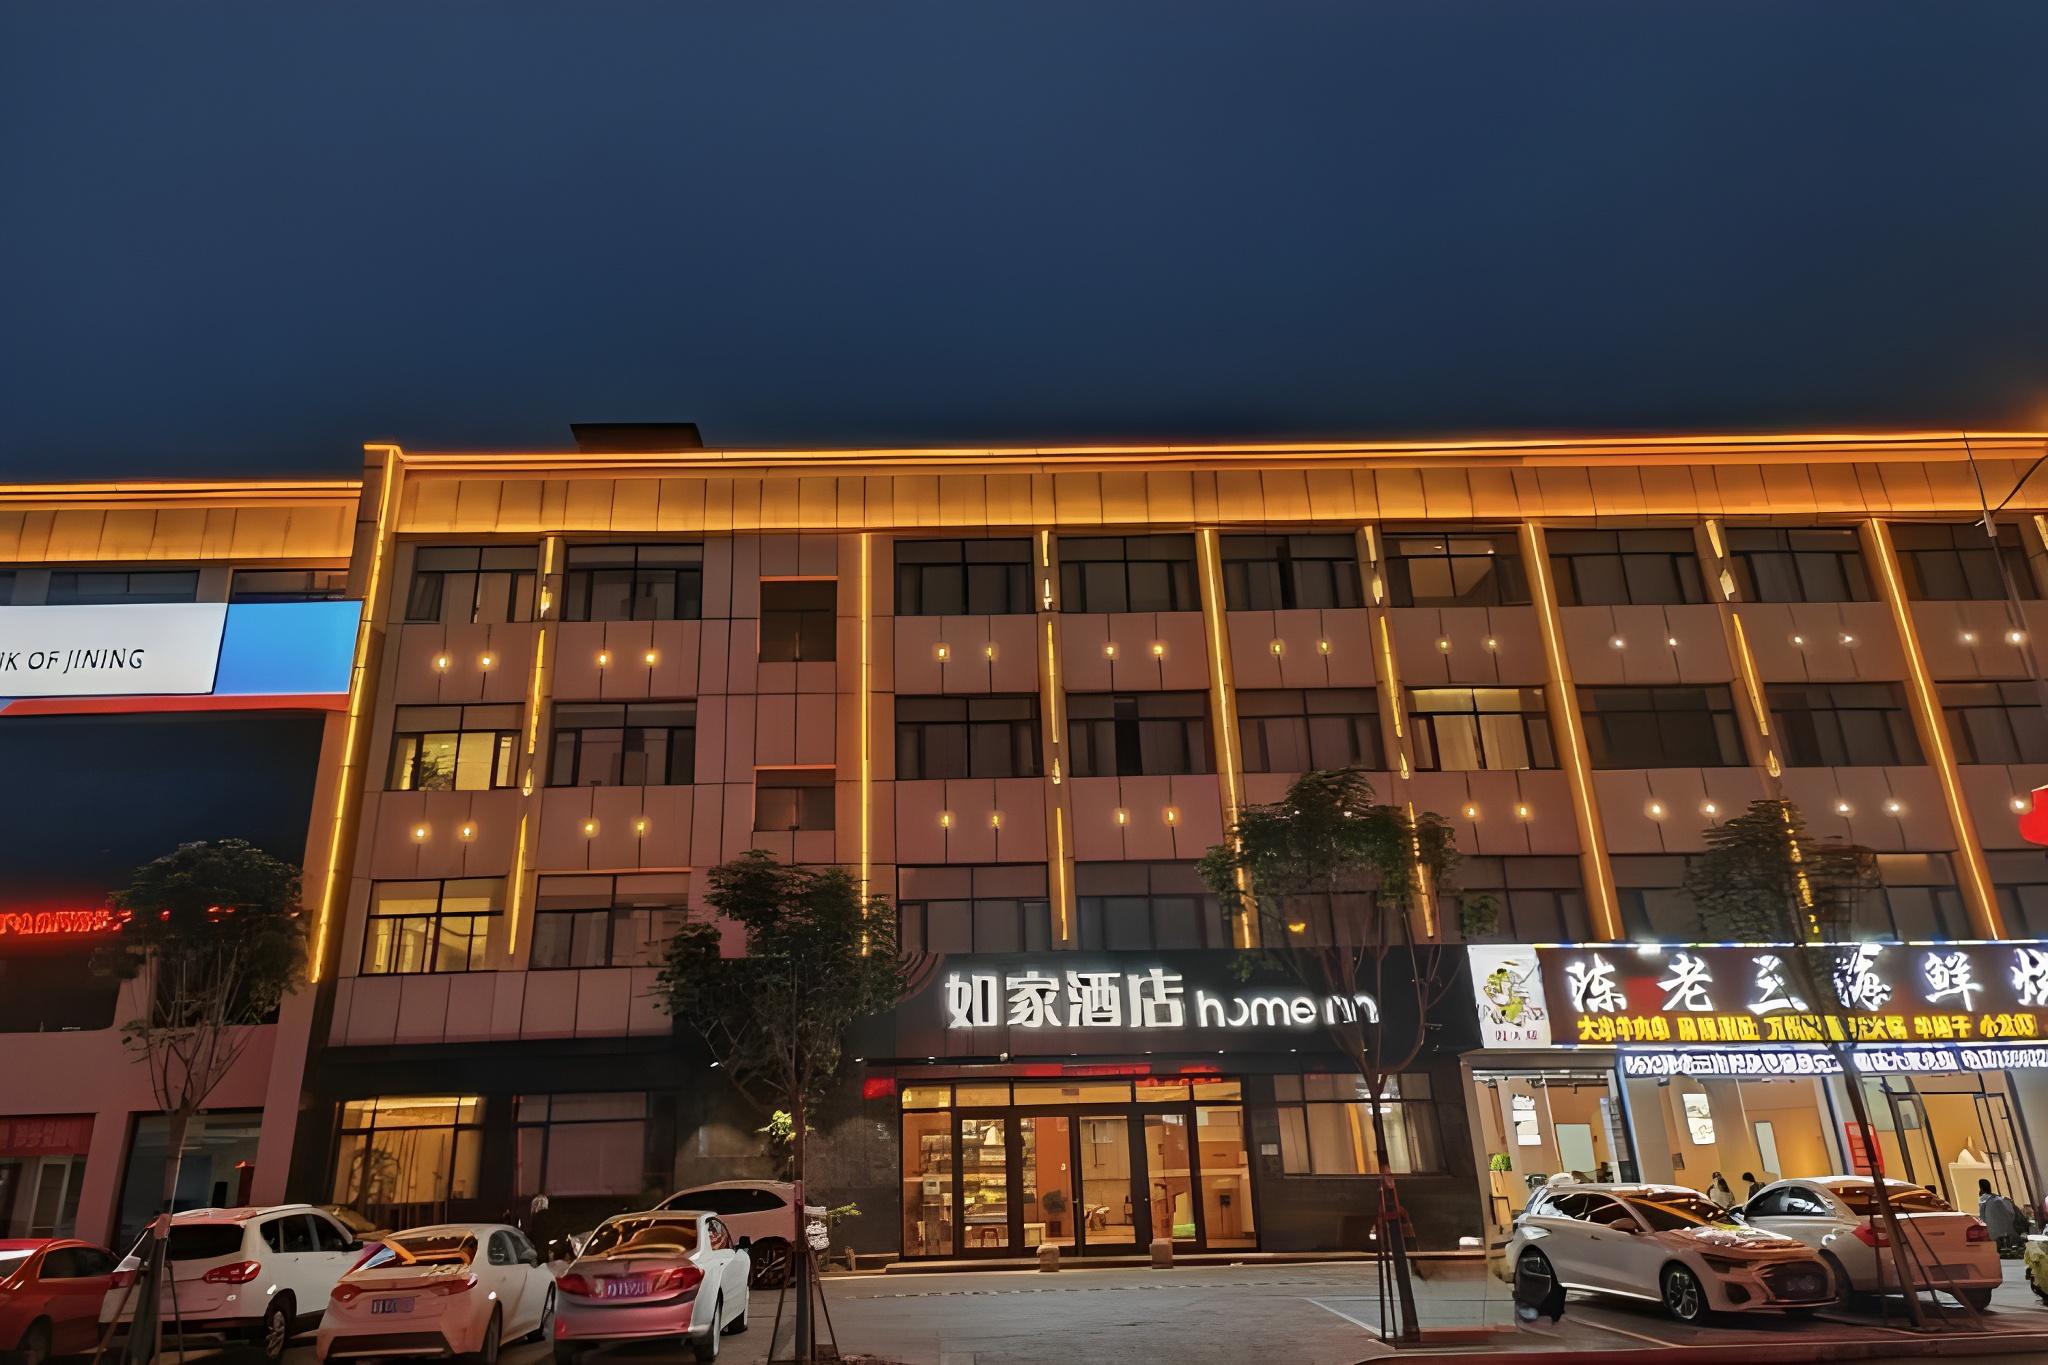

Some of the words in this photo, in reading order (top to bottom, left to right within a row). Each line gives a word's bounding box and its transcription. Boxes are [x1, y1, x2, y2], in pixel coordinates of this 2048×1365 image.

[28, 650, 60, 670] OF
[62, 648, 145, 674] JINING
[944, 968, 1185, 1028] 如家酒店
[1196, 990, 1317, 1027] home
